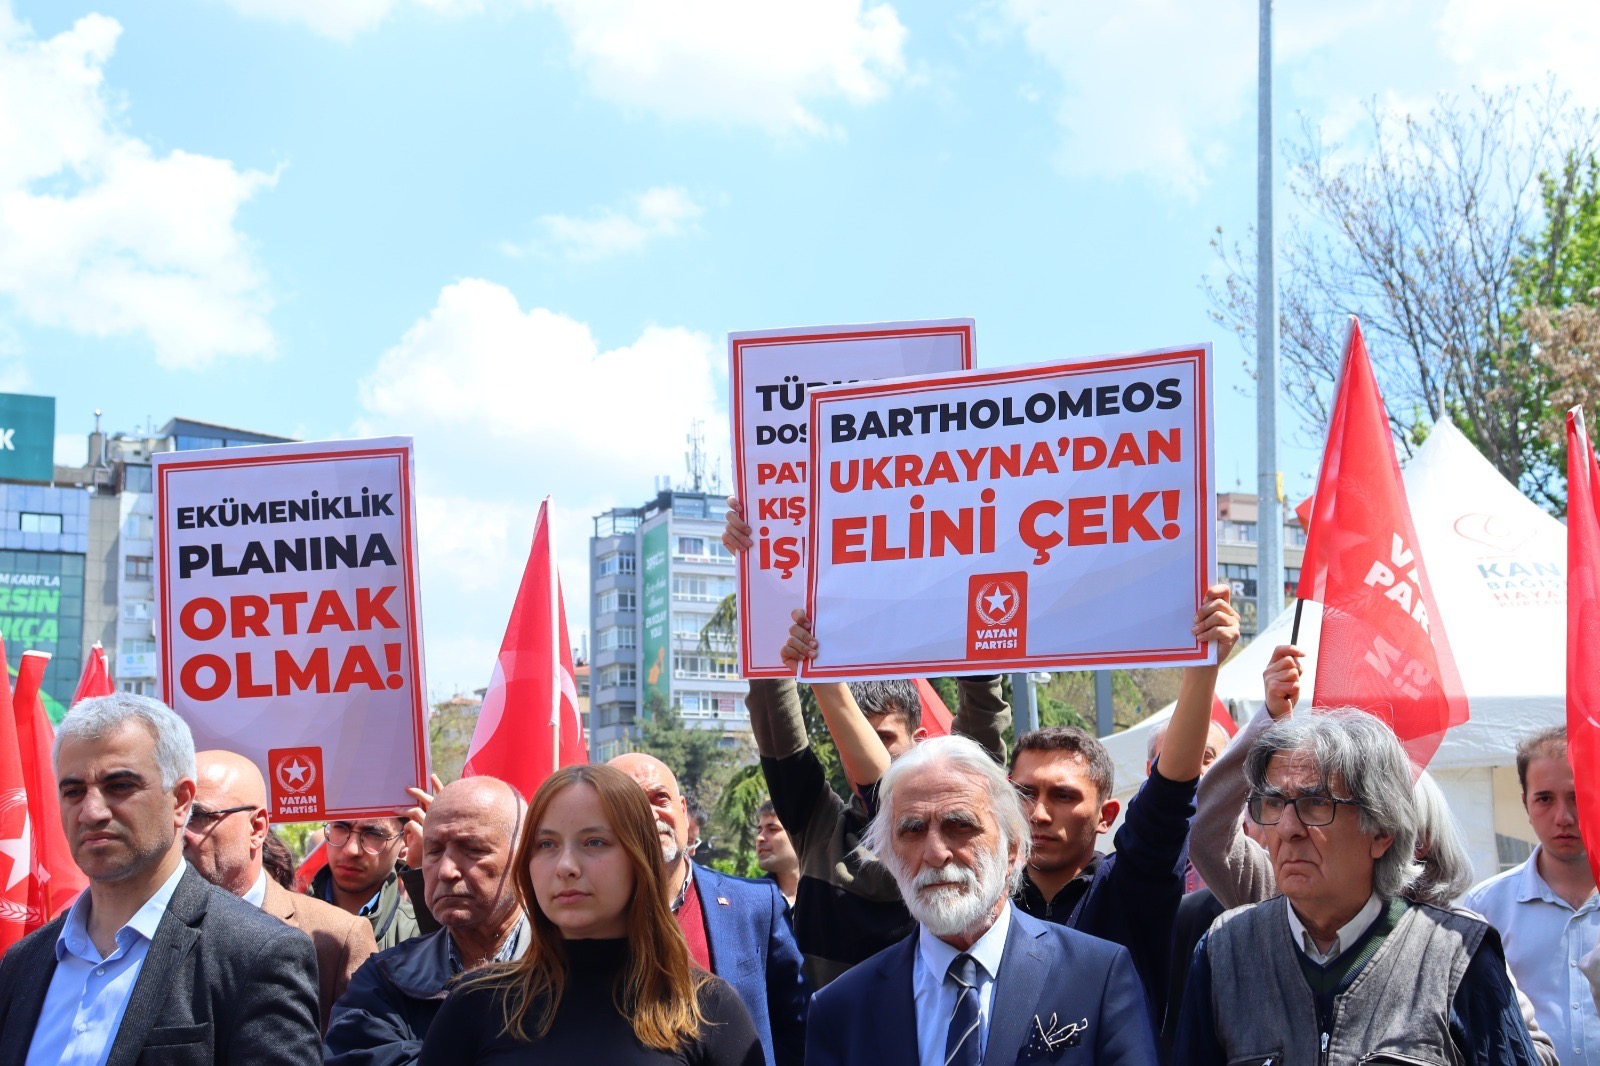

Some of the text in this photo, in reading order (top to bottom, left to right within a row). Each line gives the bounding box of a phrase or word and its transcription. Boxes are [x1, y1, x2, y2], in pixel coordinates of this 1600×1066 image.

[831, 378, 1181, 444] BARTHOLOMEOS
[177, 486, 395, 530] EKÜMENİKLİK
[832, 487, 1181, 566] ELİNİ ÇEK!
[178, 532, 397, 579] PLANINA
[1477, 561, 1562, 579] KAN
[179, 585, 401, 641] ORTAK
[976, 628, 1018, 639] VATAN
[179, 643, 404, 701] OLMA!
[279, 795, 317, 805] VATAN
